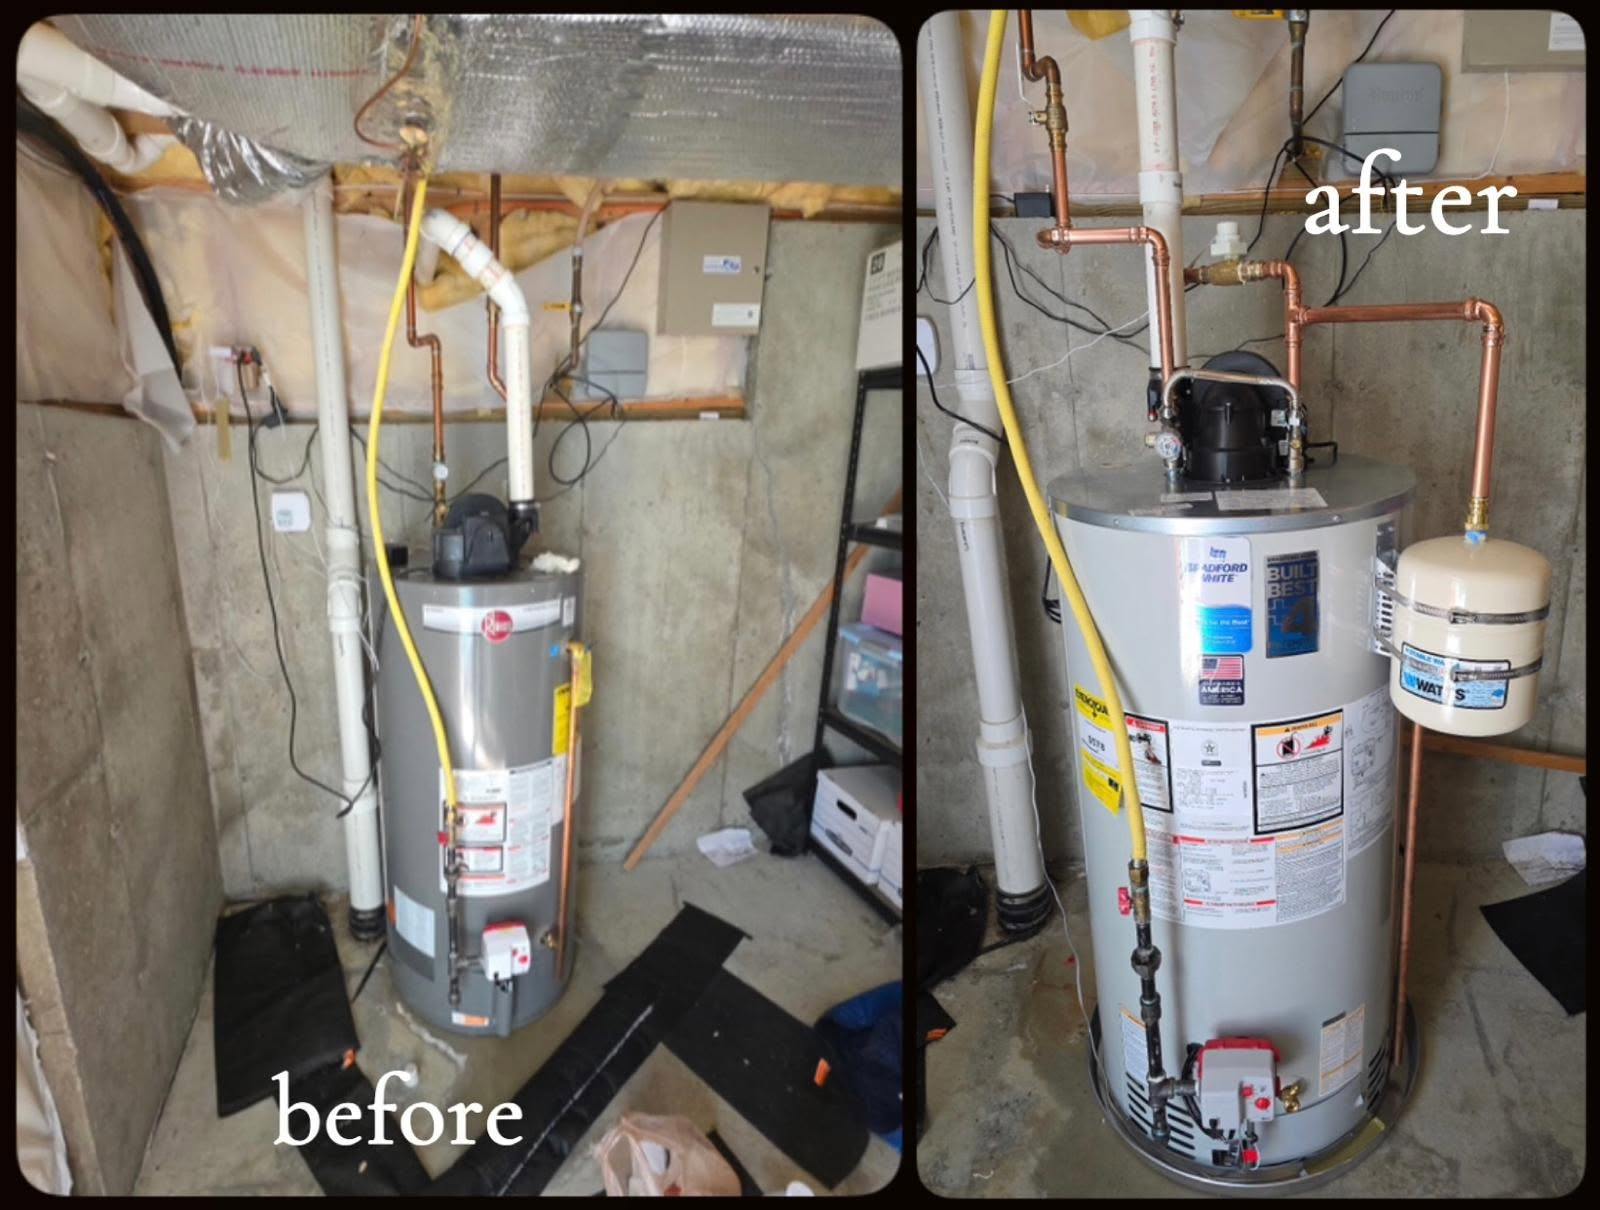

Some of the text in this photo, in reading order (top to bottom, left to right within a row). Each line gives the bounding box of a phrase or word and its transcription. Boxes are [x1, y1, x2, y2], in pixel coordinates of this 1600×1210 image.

[1266, 562, 1316, 581] BUILT
[1265, 579, 1317, 599] BEST
[1416, 677, 1466, 701] WATS
